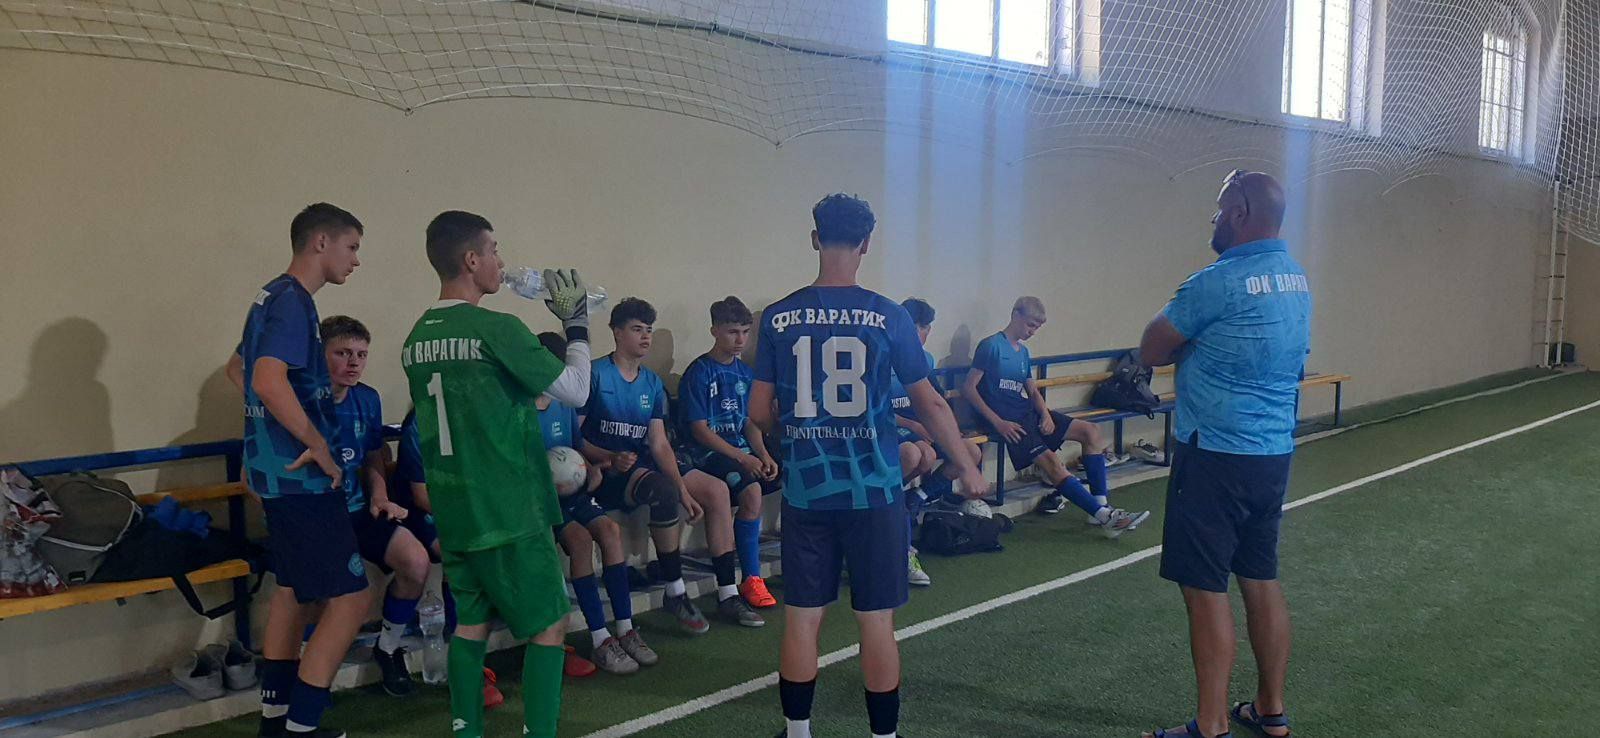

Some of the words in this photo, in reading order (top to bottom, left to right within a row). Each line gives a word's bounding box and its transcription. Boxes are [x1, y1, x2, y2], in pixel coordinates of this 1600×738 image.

[1246, 275, 1272, 295] ФК
[771, 308, 802, 333] ФК
[805, 308, 886, 330] ВАРАТИК
[415, 338, 482, 363] ВАРАТИК
[792, 335, 867, 418] 18
[427, 372, 453, 456] 1
